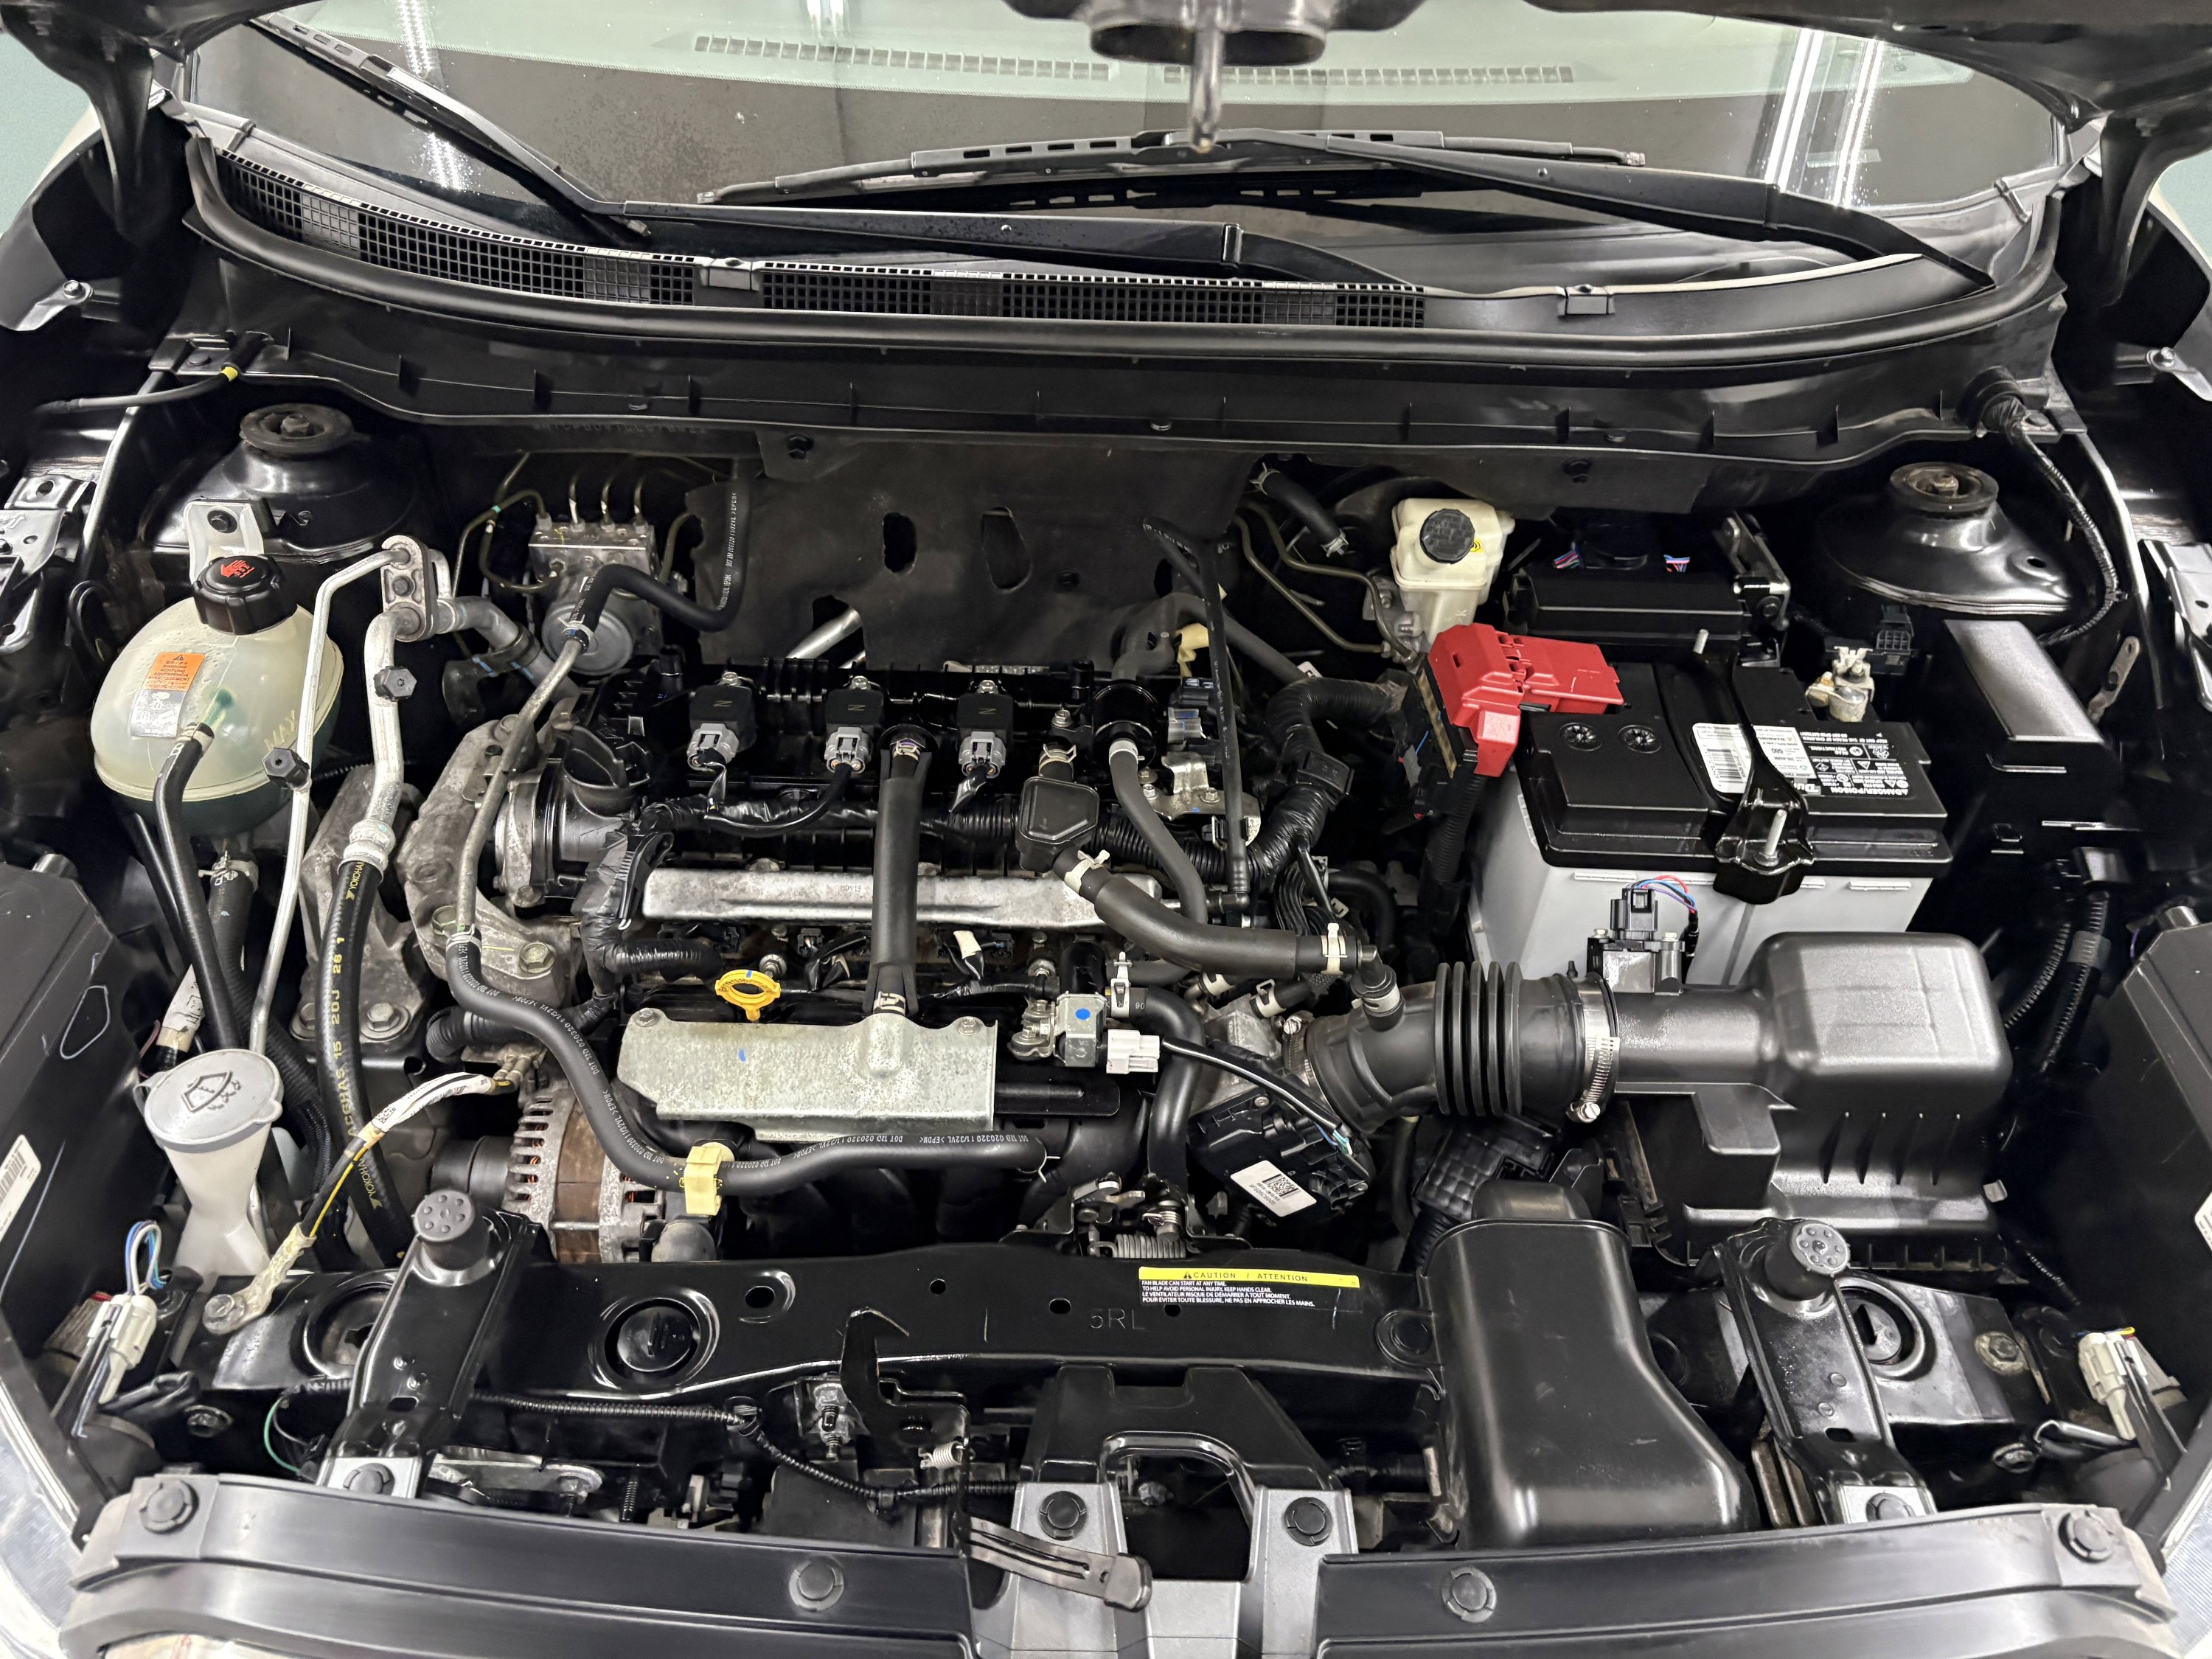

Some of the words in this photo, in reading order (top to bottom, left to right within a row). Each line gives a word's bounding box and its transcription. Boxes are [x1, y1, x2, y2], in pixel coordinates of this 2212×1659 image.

[564, 1023, 585, 1048] 020320
[333, 1040, 342, 1060] 15
[588, 1062, 600, 1074] DOT
[627, 1137, 645, 1155] 020320
[358, 1158, 377, 1198] YOKOHA
[1257, 1273, 1308, 1281] ATTENTION
